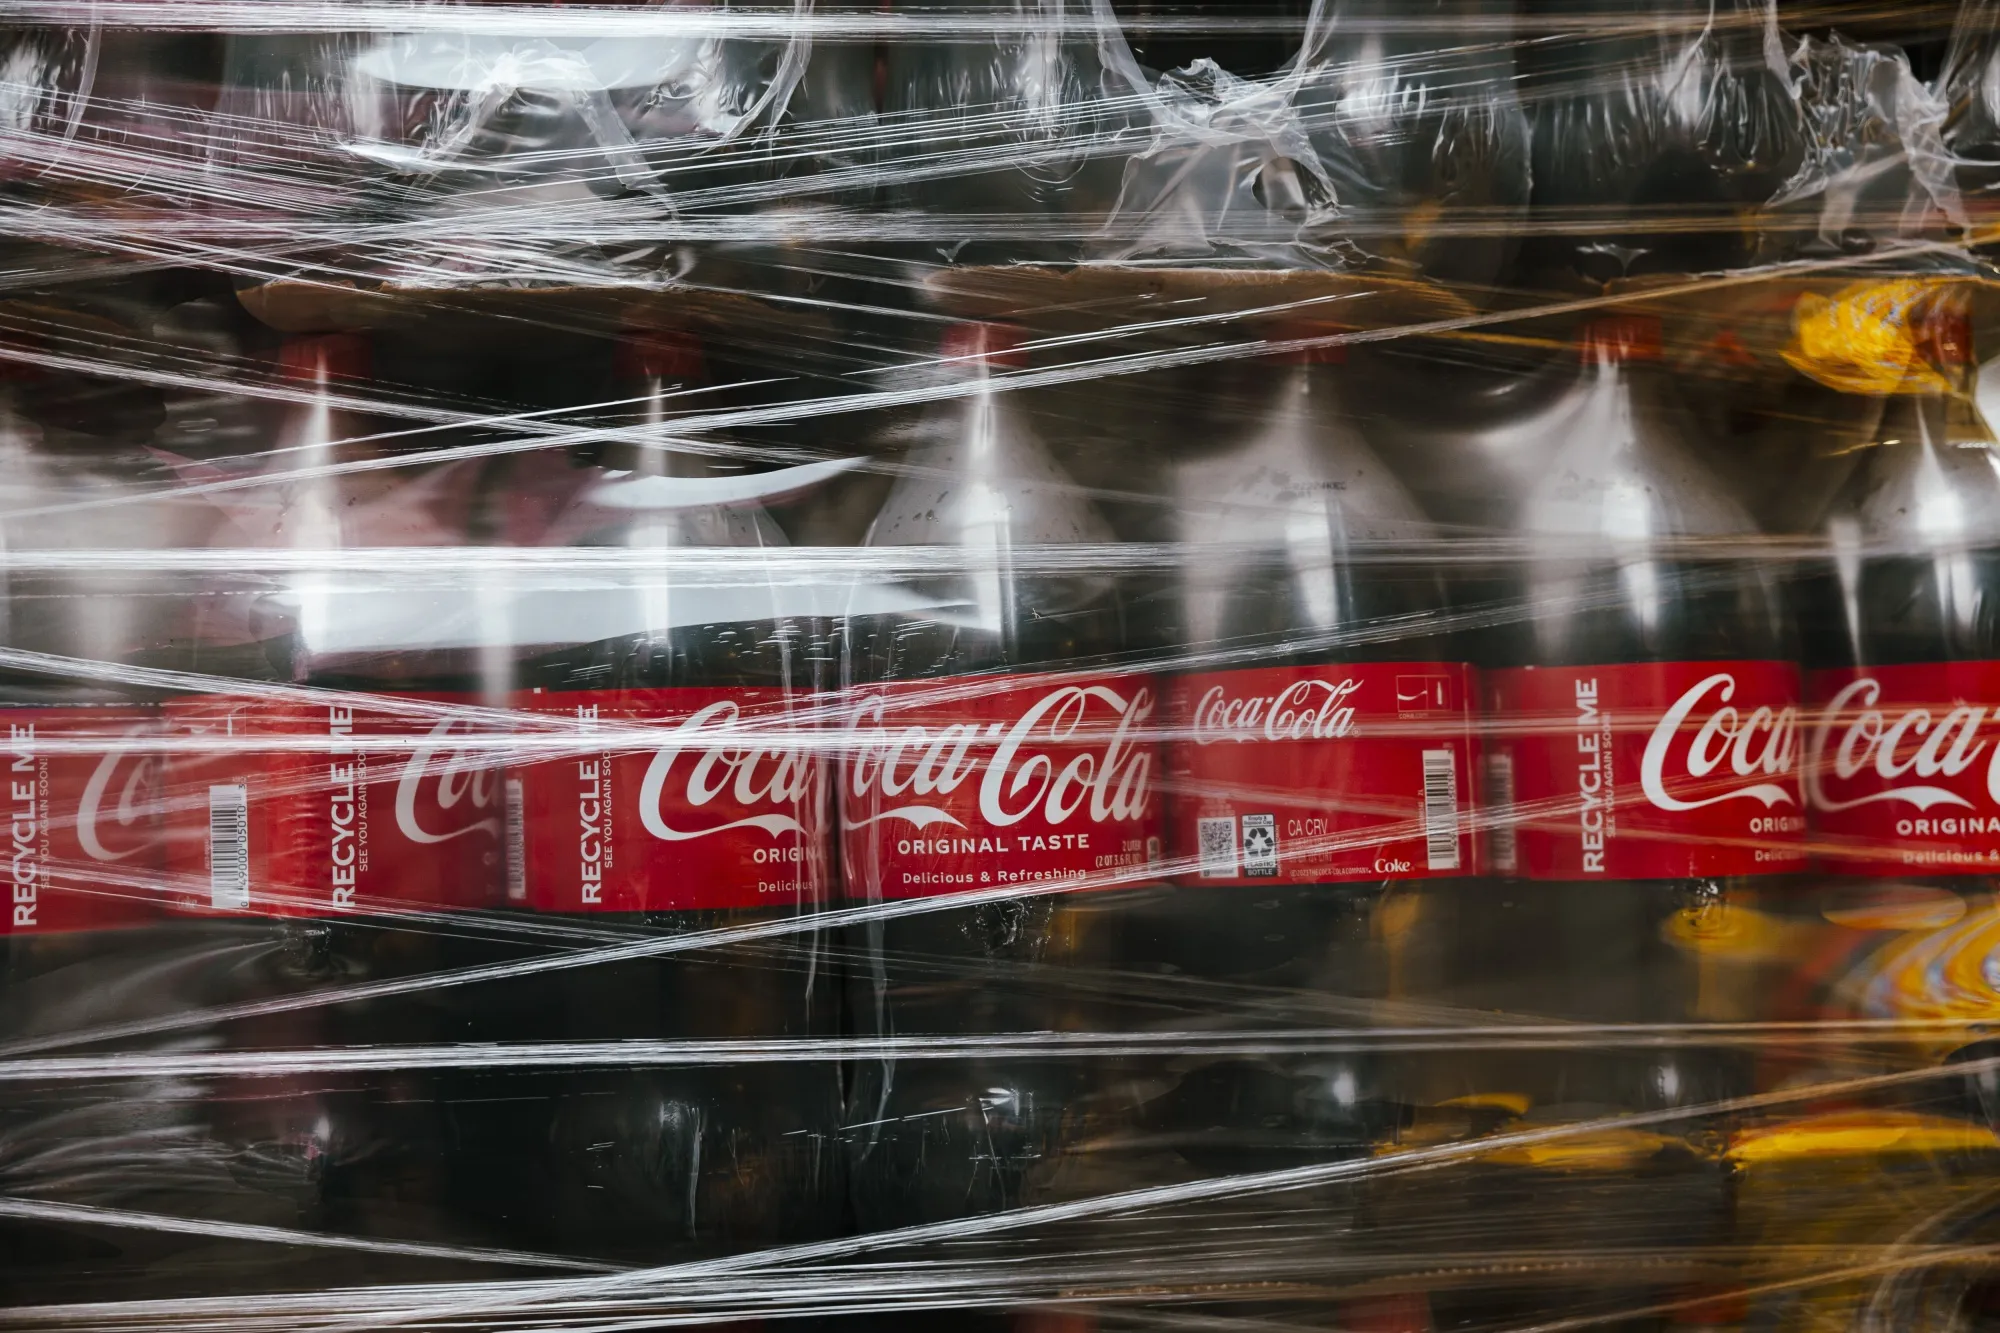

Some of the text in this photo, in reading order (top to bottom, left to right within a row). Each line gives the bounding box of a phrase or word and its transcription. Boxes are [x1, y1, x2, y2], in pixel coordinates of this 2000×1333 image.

[1194, 678, 1364, 744] Coca-Cola
[1641, 673, 1798, 811] Coca
[840, 686, 1153, 830] Coca-Cola
[1604, 751, 1613, 787] AGAIN
[1576, 678, 1605, 873] RECYCLE ME
[603, 779, 612, 817] AGAIN
[11, 723, 37, 926] RECYCLE ME
[237, 805, 246, 842] 05010
[331, 763, 356, 907] RECYCLE
[359, 821, 368, 845] YOU
[579, 760, 602, 903] RECYCLE
[604, 818, 612, 844] YOU
[1287, 818, 1328, 836] CA CRV
[604, 845, 613, 868] SEE
[897, 833, 1090, 855] ORIGINAL TASTE
[1902, 850, 1983, 864] Delicious
[359, 848, 368, 872] SEE
[902, 867, 1087, 884] Delicious & Refreshing
[1247, 868, 1273, 876] BOTTLE
[1374, 858, 1411, 874] Coke
